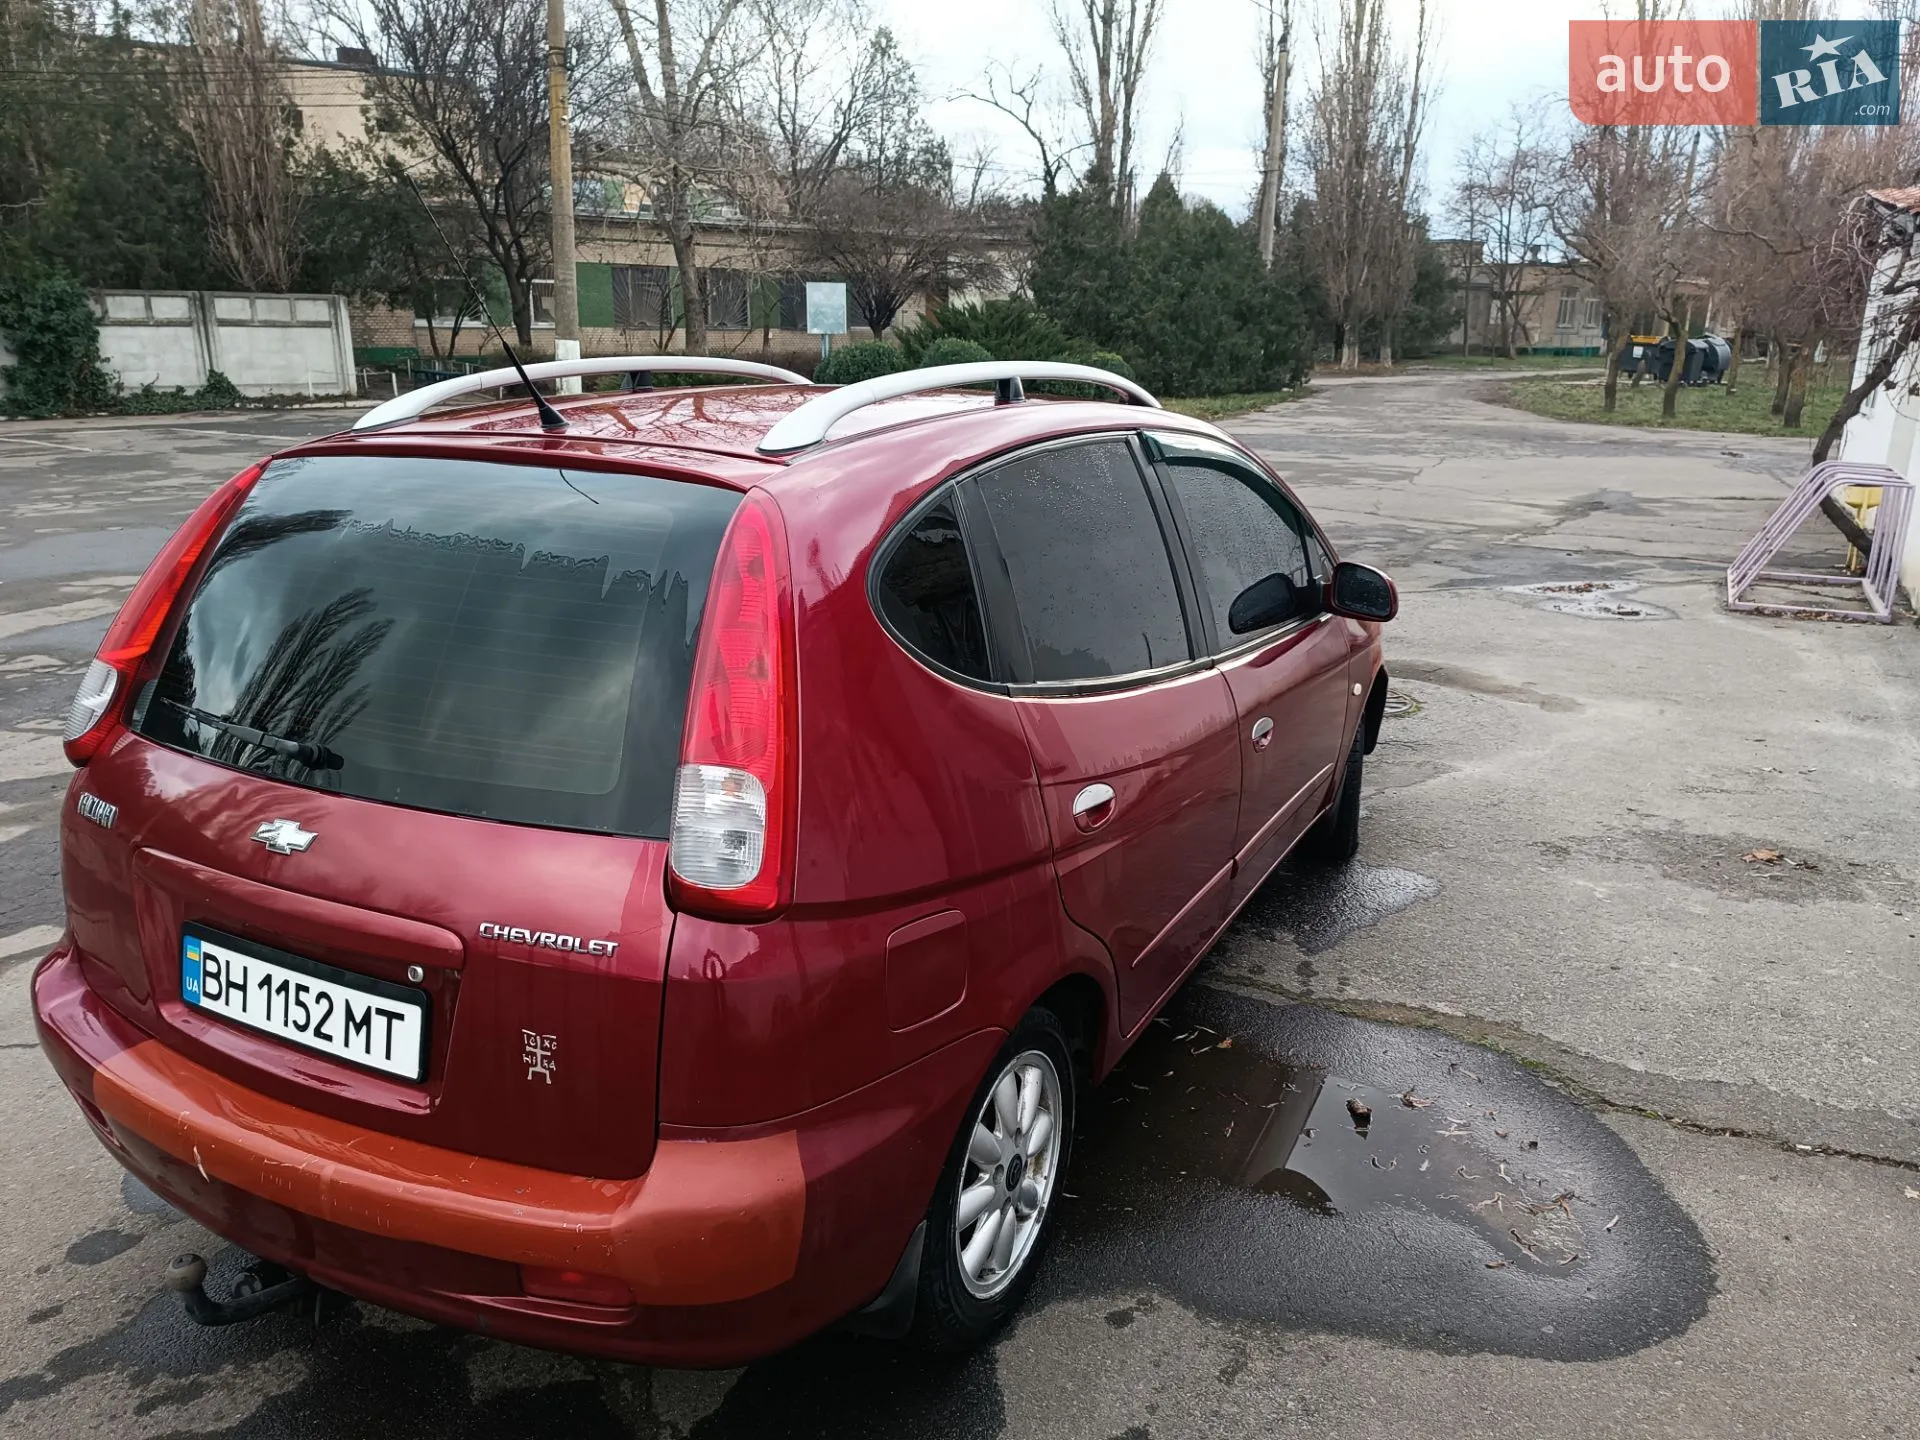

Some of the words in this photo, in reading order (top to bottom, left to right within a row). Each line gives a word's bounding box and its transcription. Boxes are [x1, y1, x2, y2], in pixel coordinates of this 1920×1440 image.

[479, 921, 620, 957] CHEVROLET
[186, 975, 200, 994] UA
[202, 950, 249, 1014] BH
[257, 973, 335, 1043] 1152
[343, 998, 406, 1061] MT
